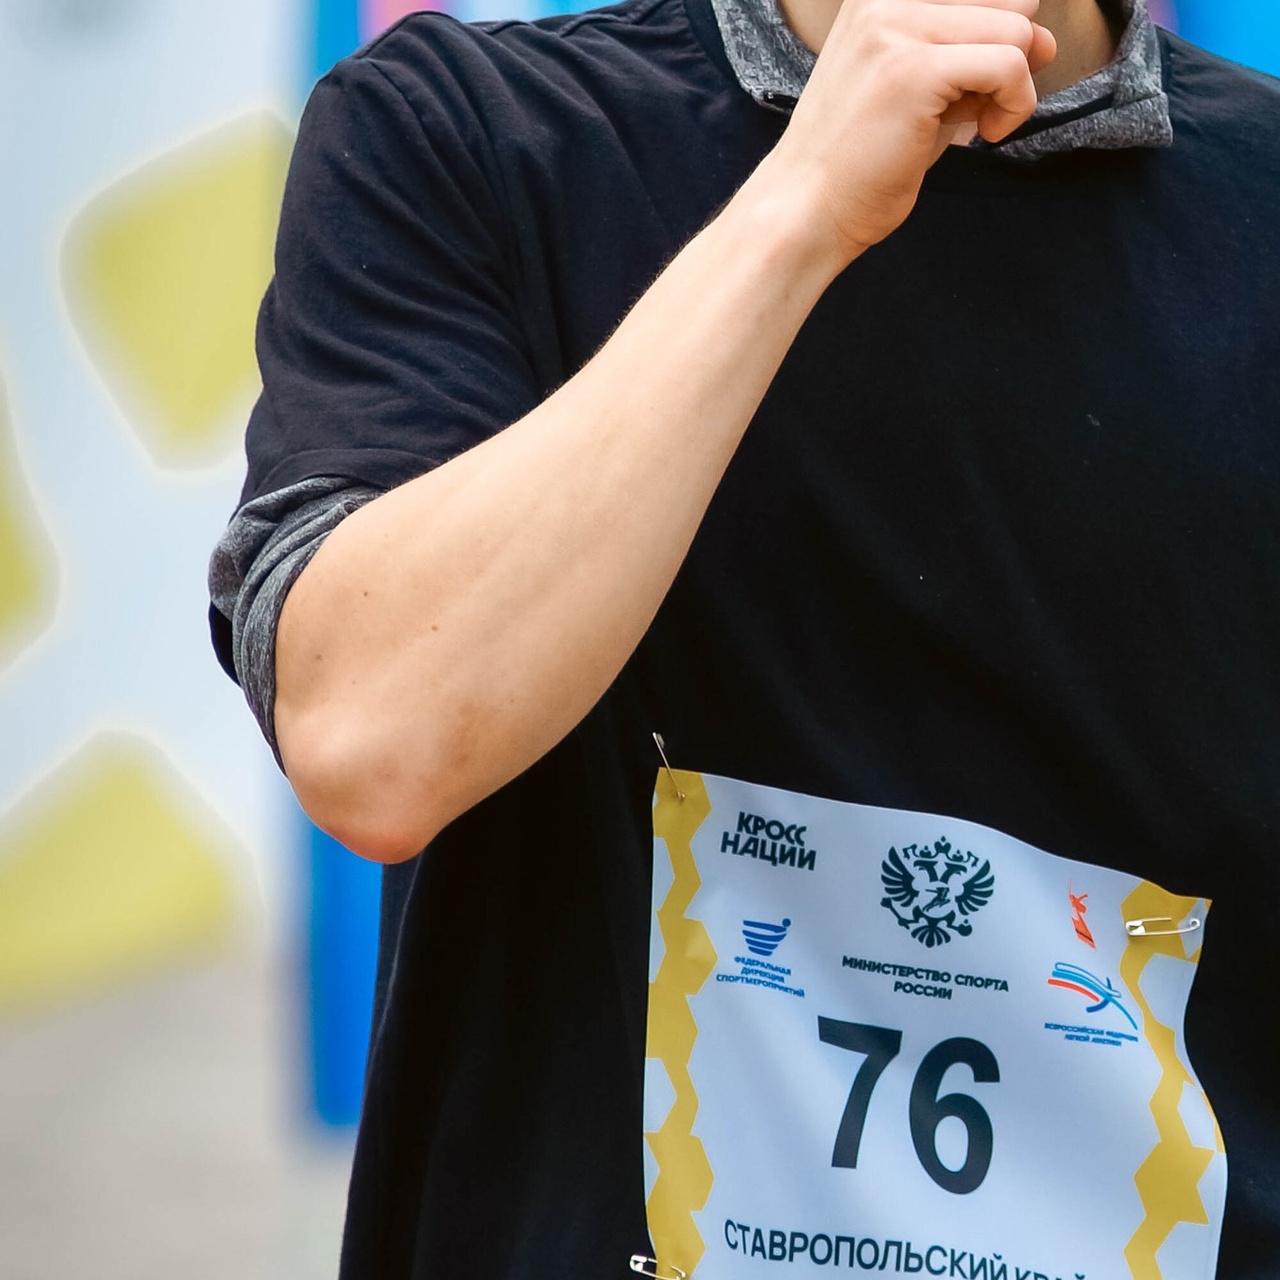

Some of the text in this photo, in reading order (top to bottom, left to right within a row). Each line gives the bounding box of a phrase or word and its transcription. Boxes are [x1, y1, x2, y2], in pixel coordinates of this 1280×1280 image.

[737, 811, 807, 847] КРОСС
[720, 831, 817, 871] НАЦИИ
[734, 956, 791, 976] ФЕДЕРАЛЬНАЯ
[842, 955, 1009, 992] МИНИСТЕРСТВО СПОРТА
[893, 981, 953, 1000] РОССИИ
[817, 1015, 1001, 1195] 76
